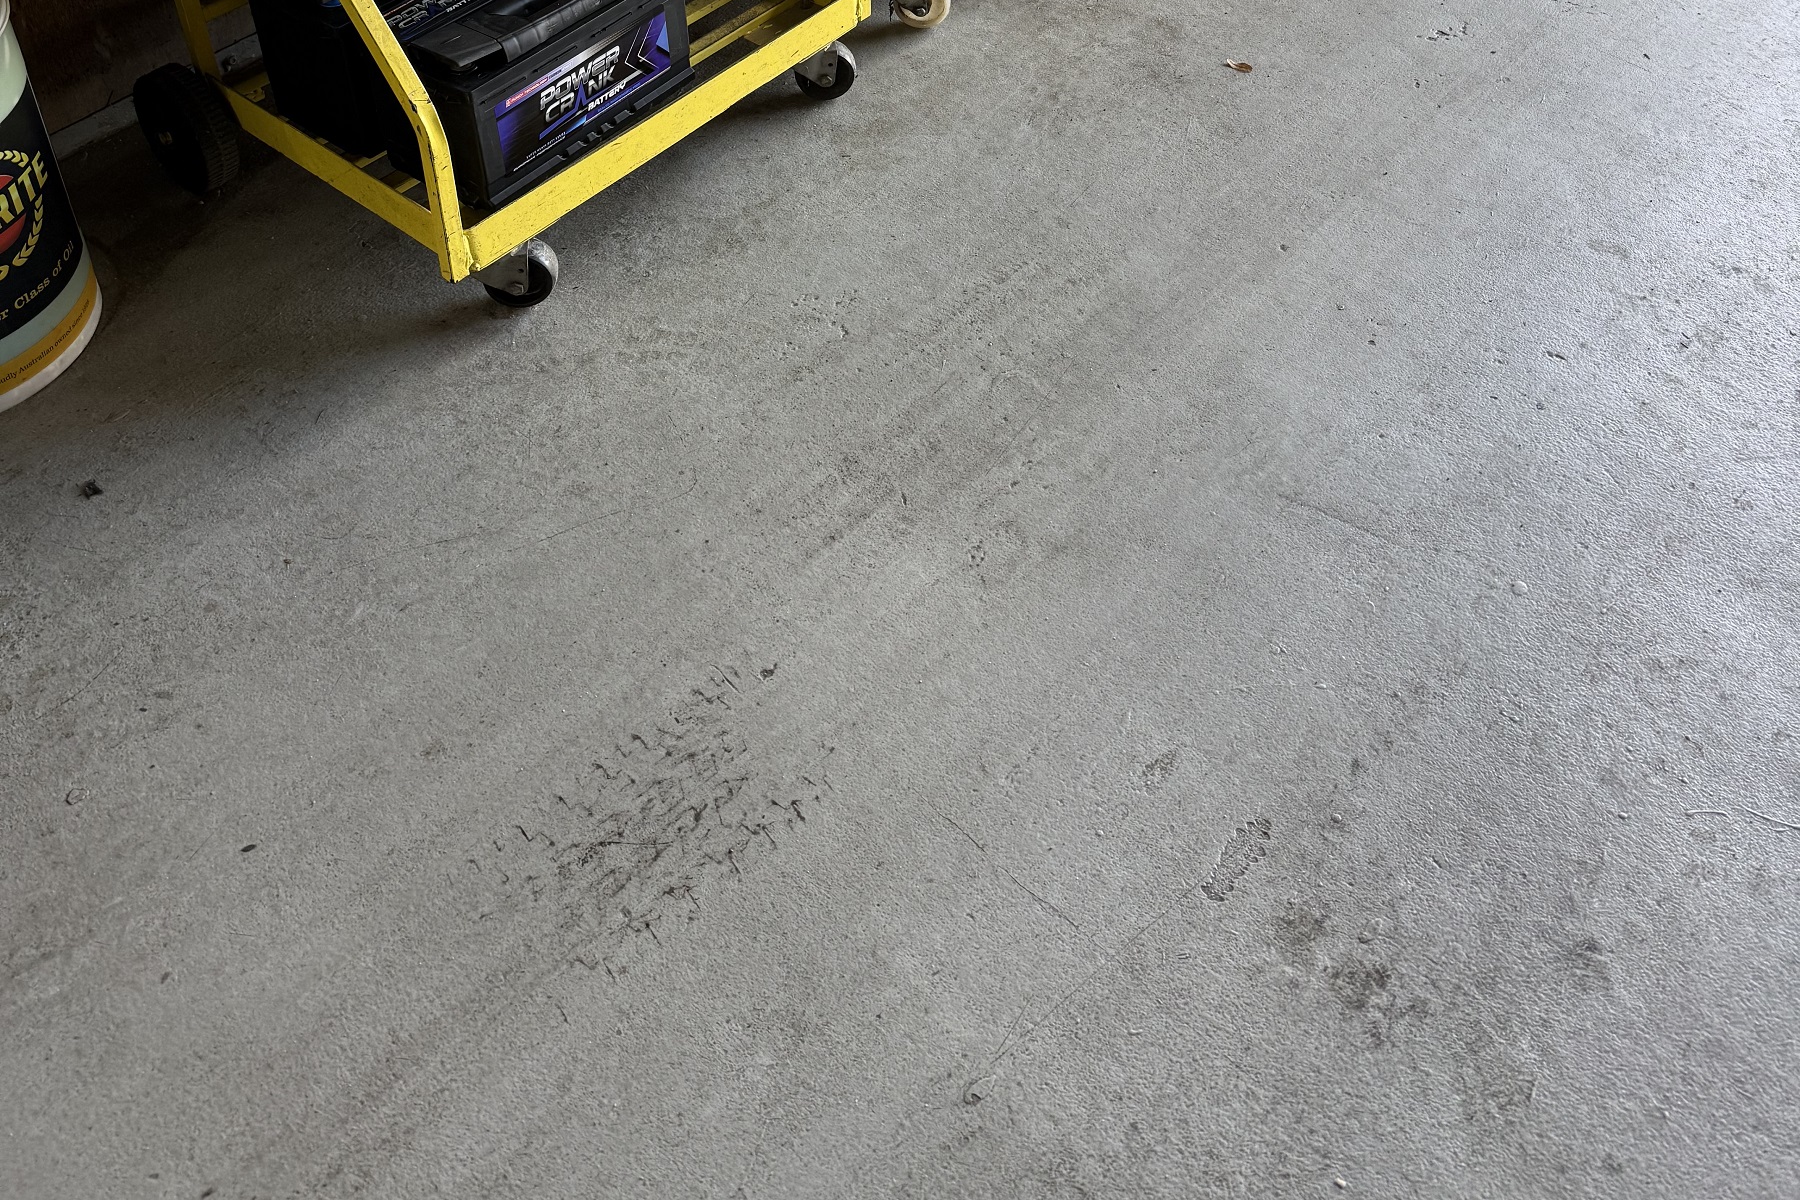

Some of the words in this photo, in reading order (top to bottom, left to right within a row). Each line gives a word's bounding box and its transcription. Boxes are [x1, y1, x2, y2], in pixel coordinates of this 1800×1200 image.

[540, 45, 620, 111] POWER
[588, 81, 627, 112] BATTERY
[0, 150, 48, 224] RITE
[14, 276, 51, 310] Class
[52, 259, 62, 277] of
[63, 240, 74, 261] Oil
[0, 371, 18, 386] udly
[18, 345, 54, 374] Australian
[54, 327, 72, 347] owned
